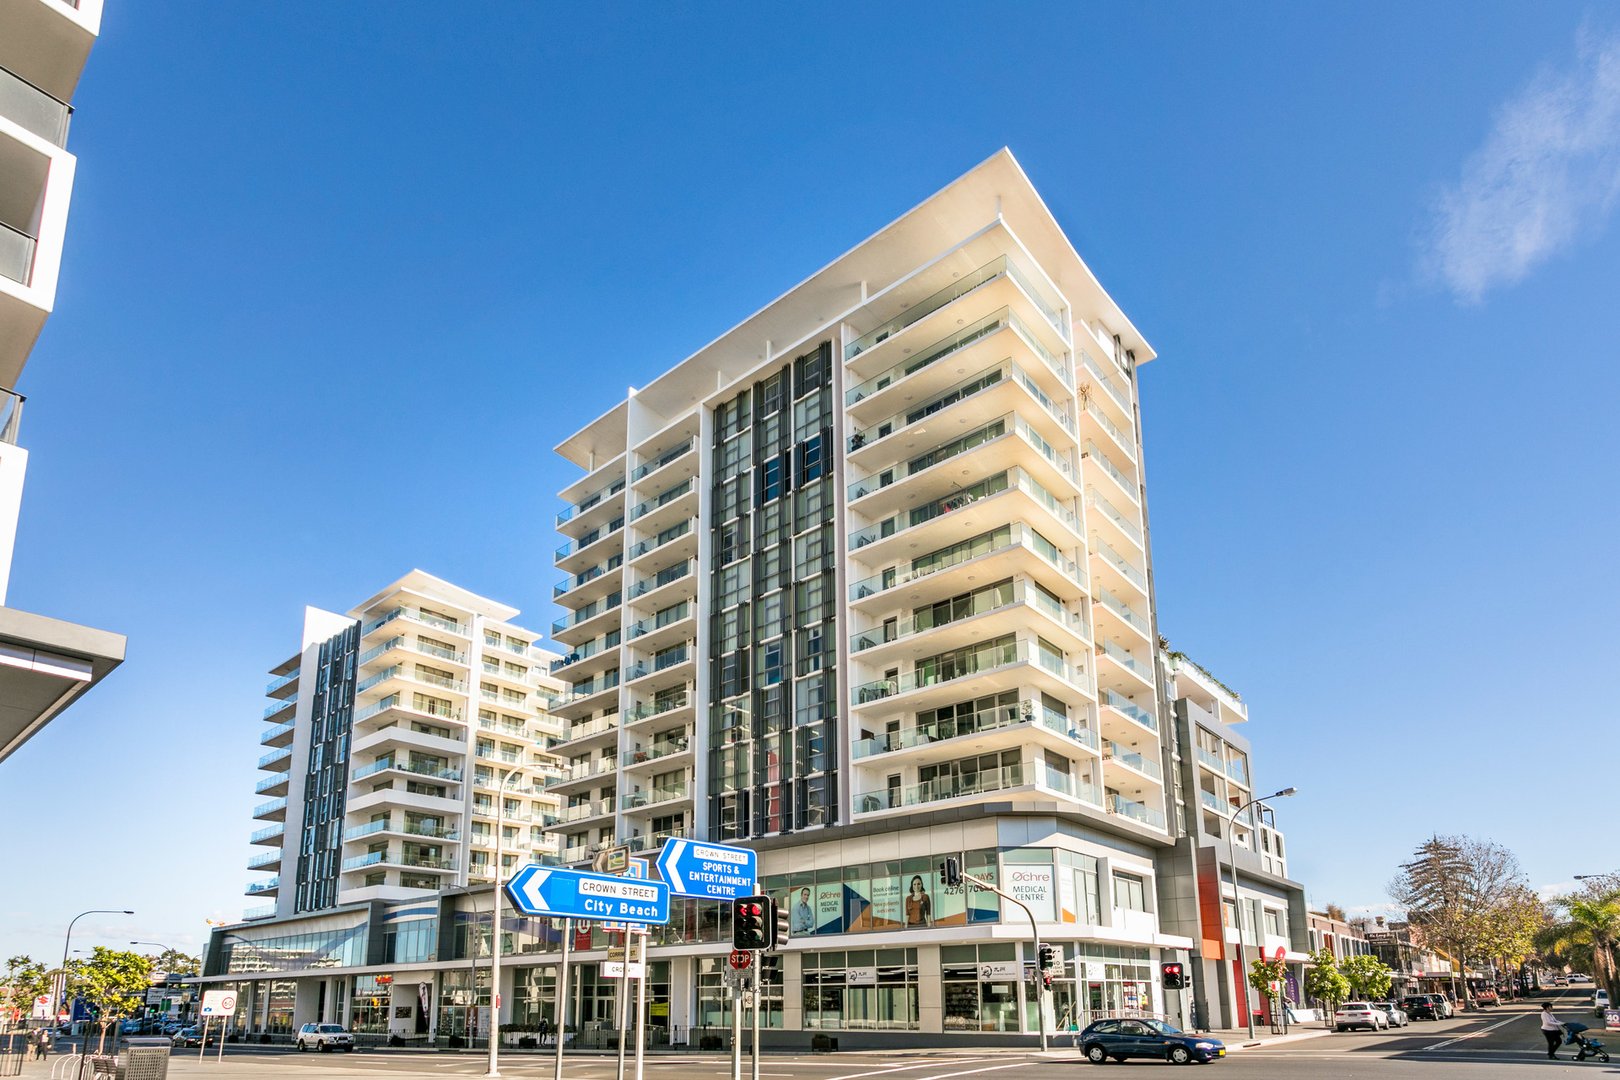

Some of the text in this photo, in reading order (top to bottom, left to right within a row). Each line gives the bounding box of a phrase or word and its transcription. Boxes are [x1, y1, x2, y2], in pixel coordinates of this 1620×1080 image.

[695, 849, 746, 862] CROWN STREET
[702, 861, 740, 875] SPORTS &
[689, 871, 752, 887] ENTERTAINMENT
[582, 882, 655, 898] CROWN STREET
[706, 884, 736, 896] CENTRE
[944, 887, 964, 896] 4276
[1012, 885, 1047, 893] MEDICAL
[1015, 893, 1045, 901] CENTRE
[584, 898, 658, 917] City Beach
[731, 954, 750, 964] STOP
